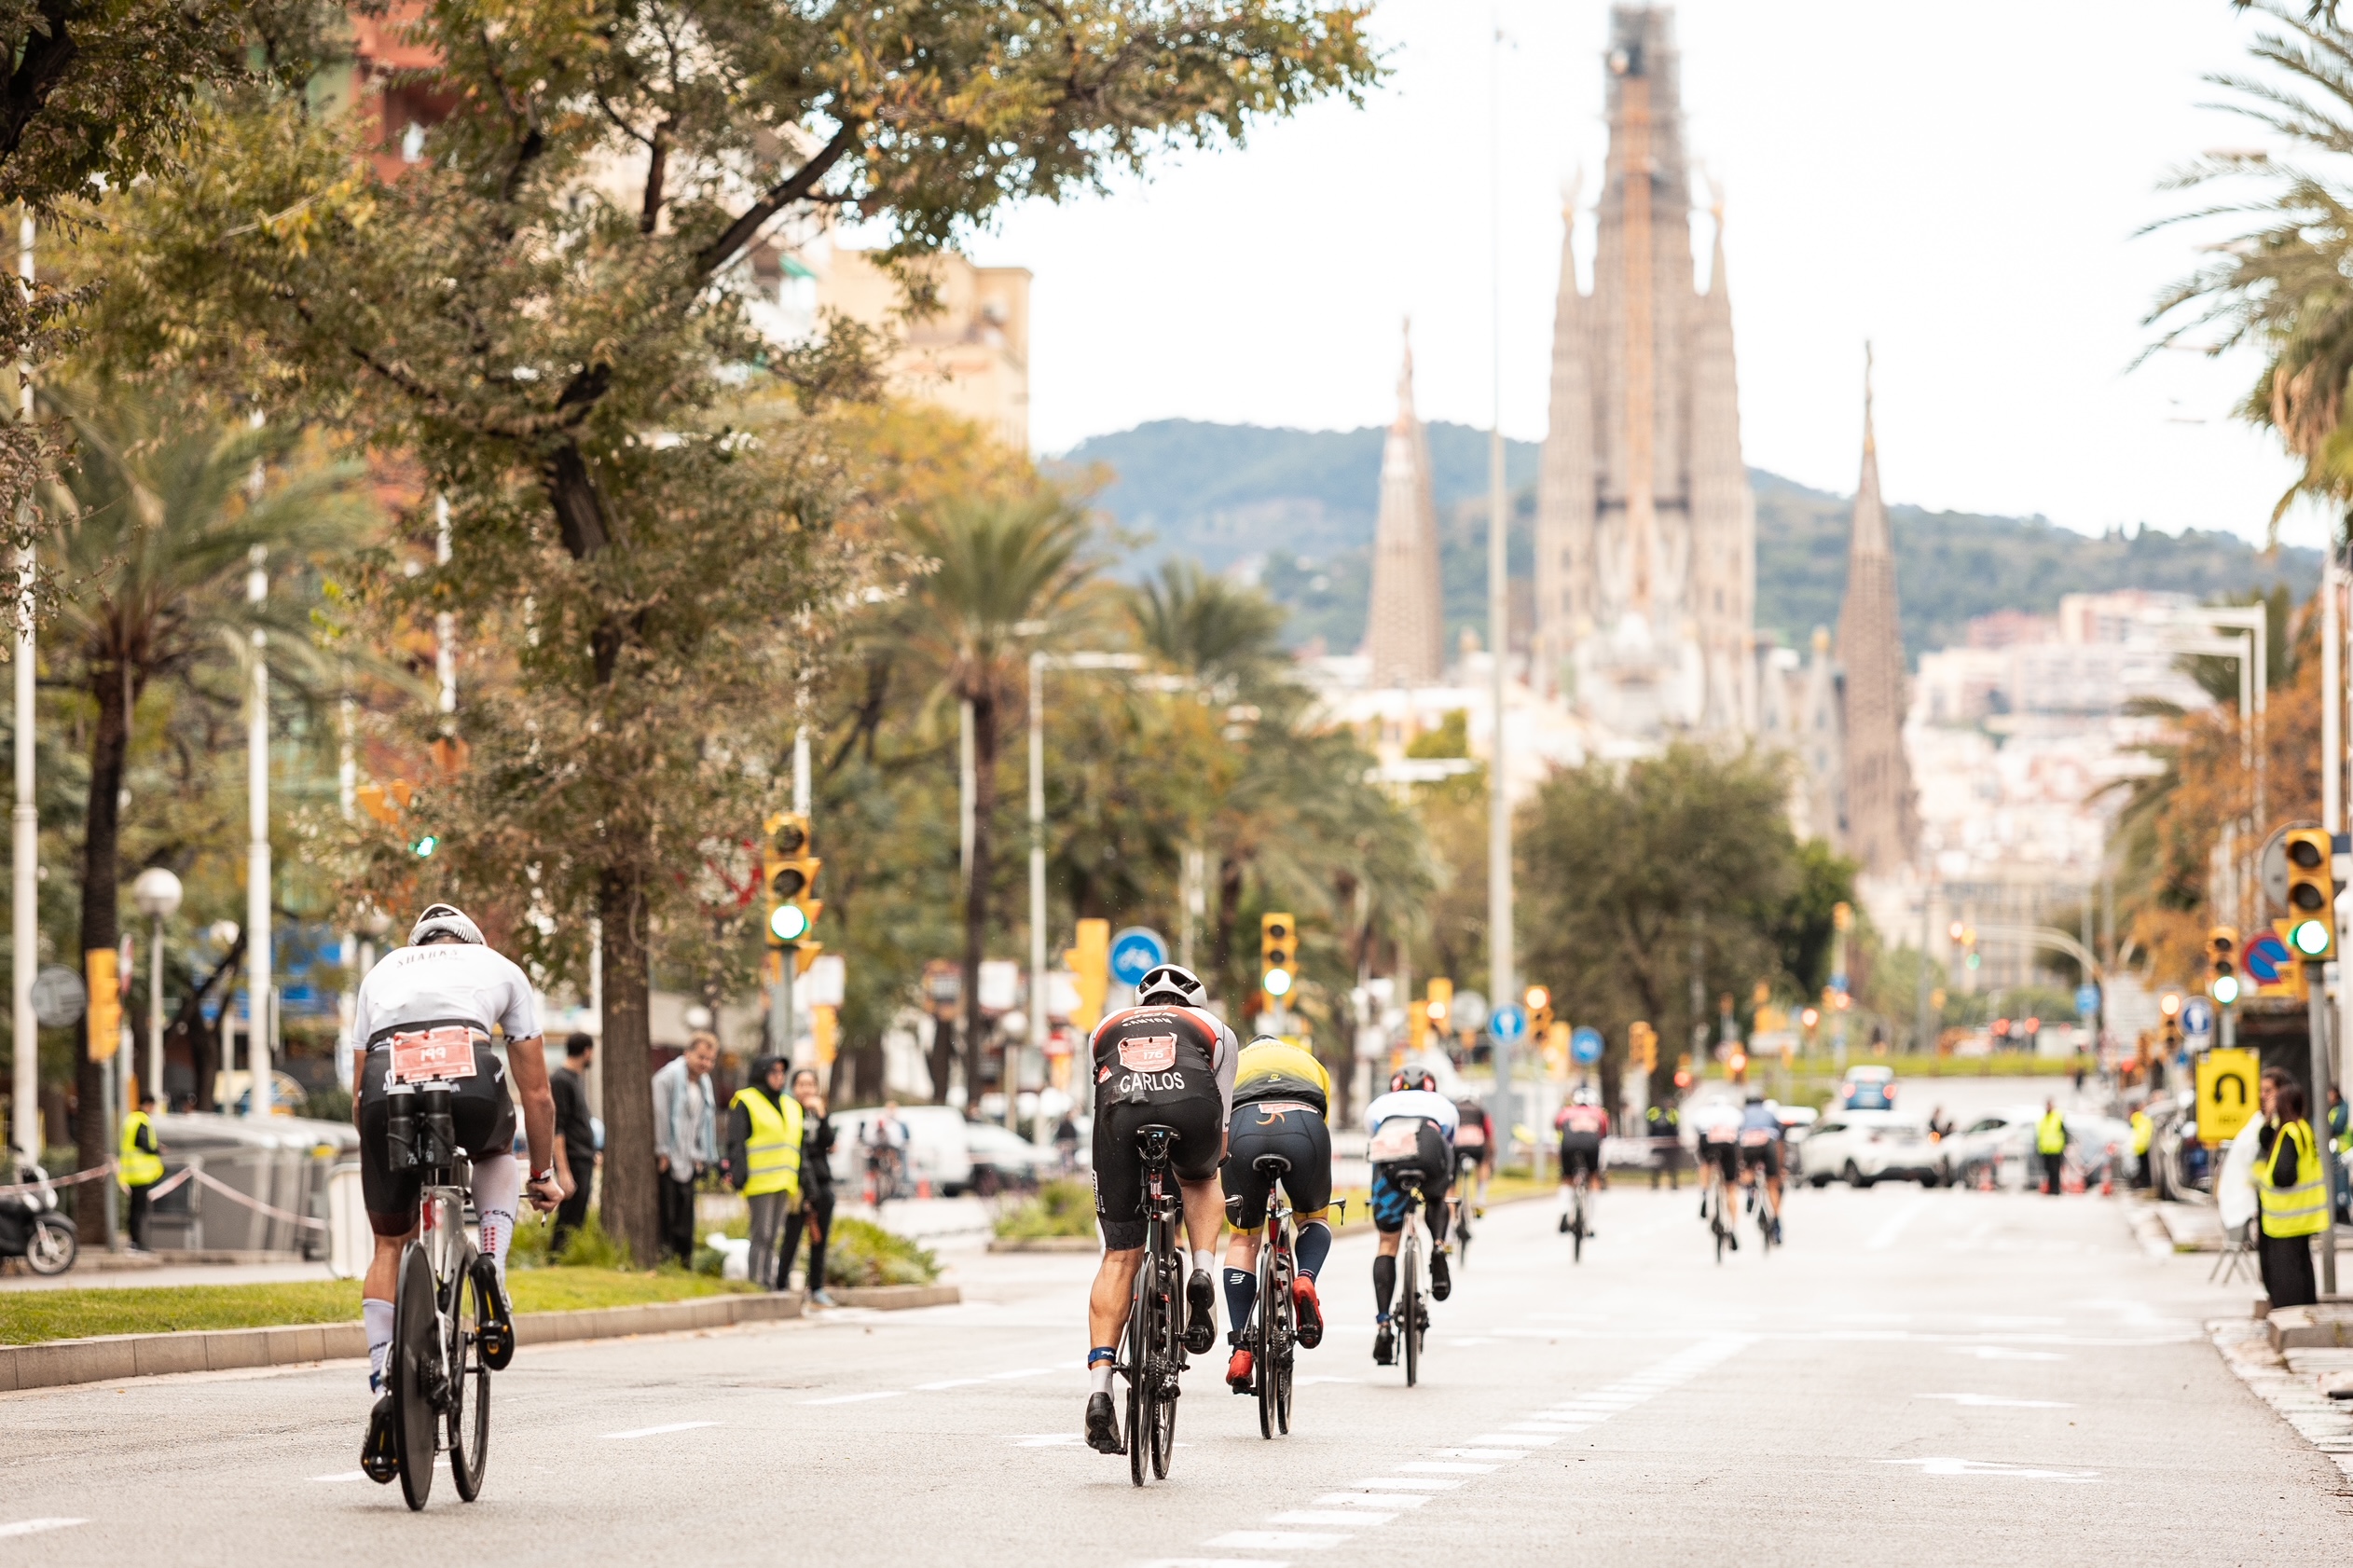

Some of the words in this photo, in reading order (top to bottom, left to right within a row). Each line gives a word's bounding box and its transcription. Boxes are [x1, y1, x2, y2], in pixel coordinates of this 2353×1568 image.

[397, 949, 459, 968] SHARKS
[420, 1047, 447, 1062] 199
[1143, 1051, 1163, 1060] 176
[1120, 1072, 1185, 1093] CARLOS
